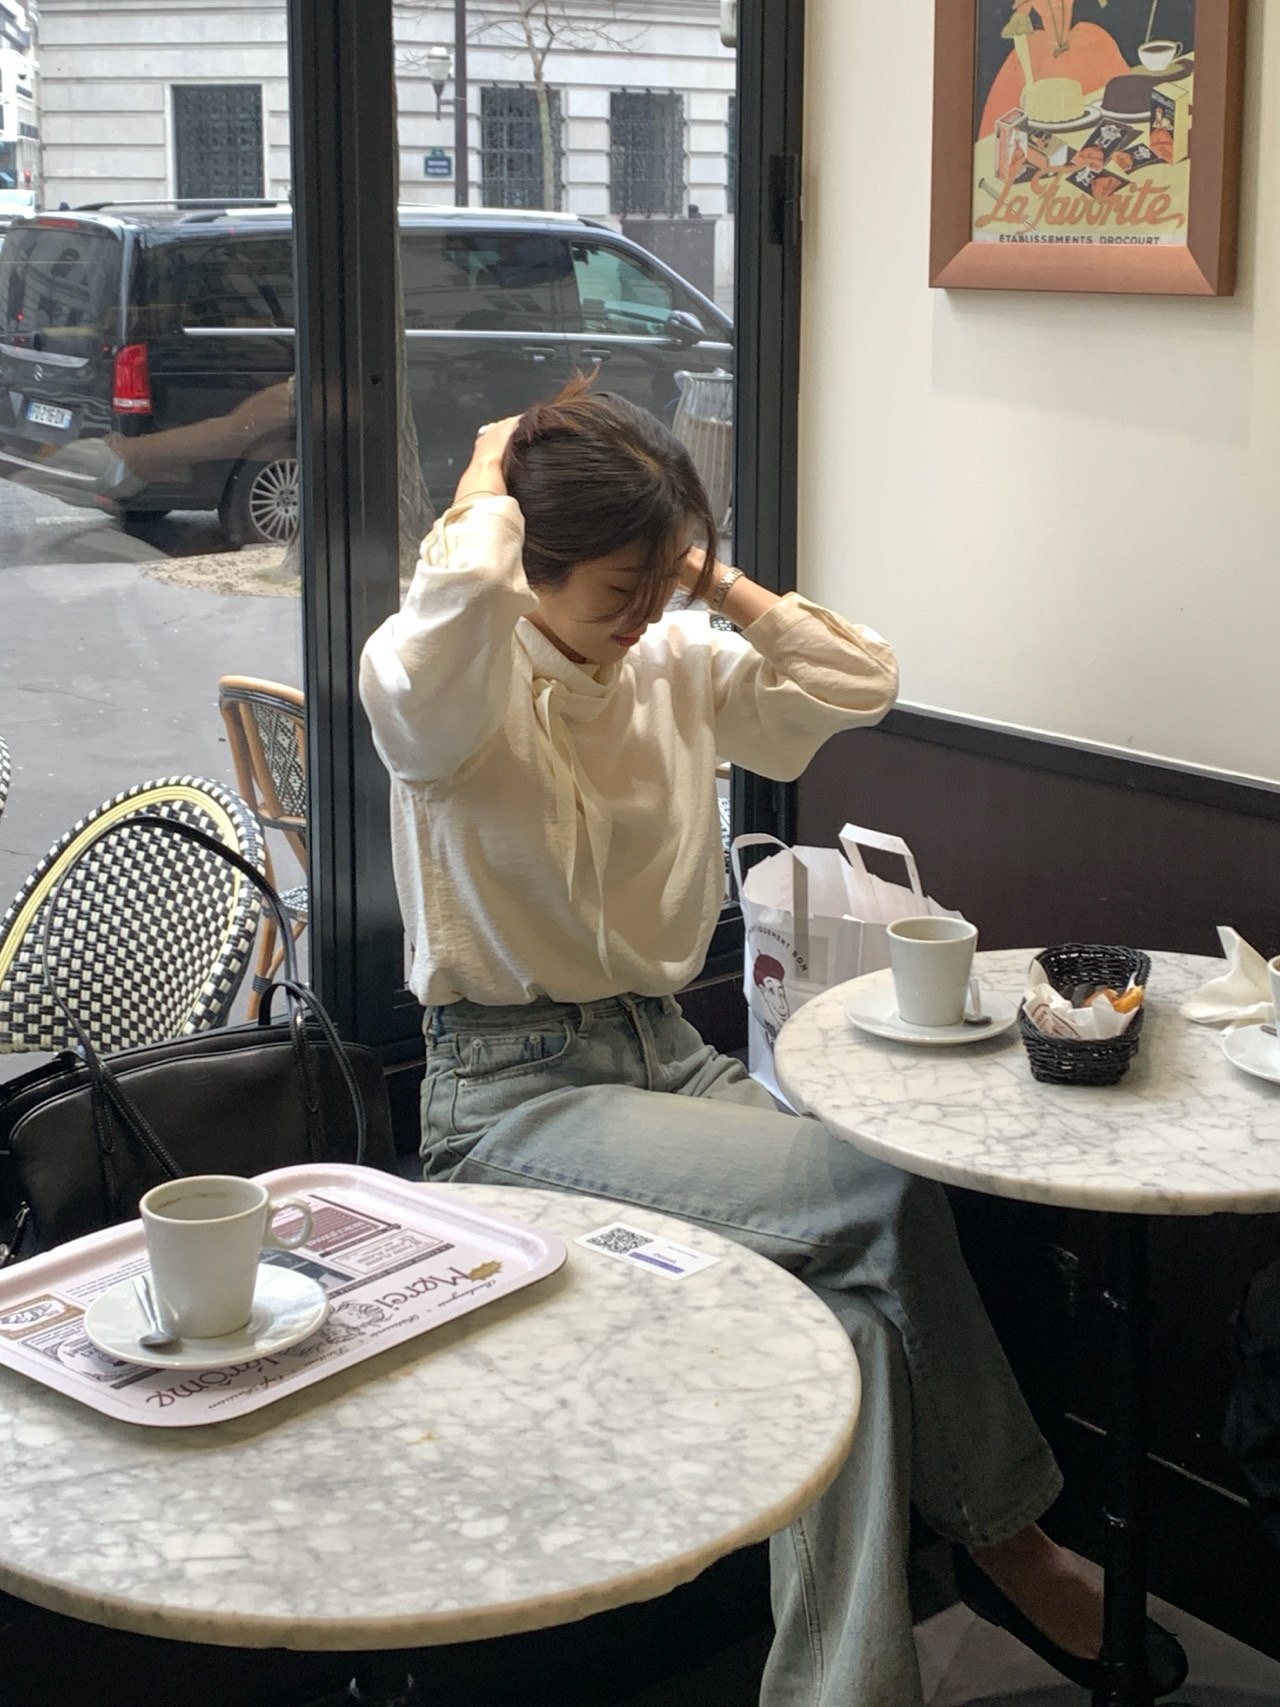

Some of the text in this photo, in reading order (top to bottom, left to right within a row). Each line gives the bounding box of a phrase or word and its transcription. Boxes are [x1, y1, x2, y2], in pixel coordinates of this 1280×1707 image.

[1016, 164, 1185, 234] Favorite
[792, 950, 808, 971] BON
[374, 1266, 470, 1311] Merci
